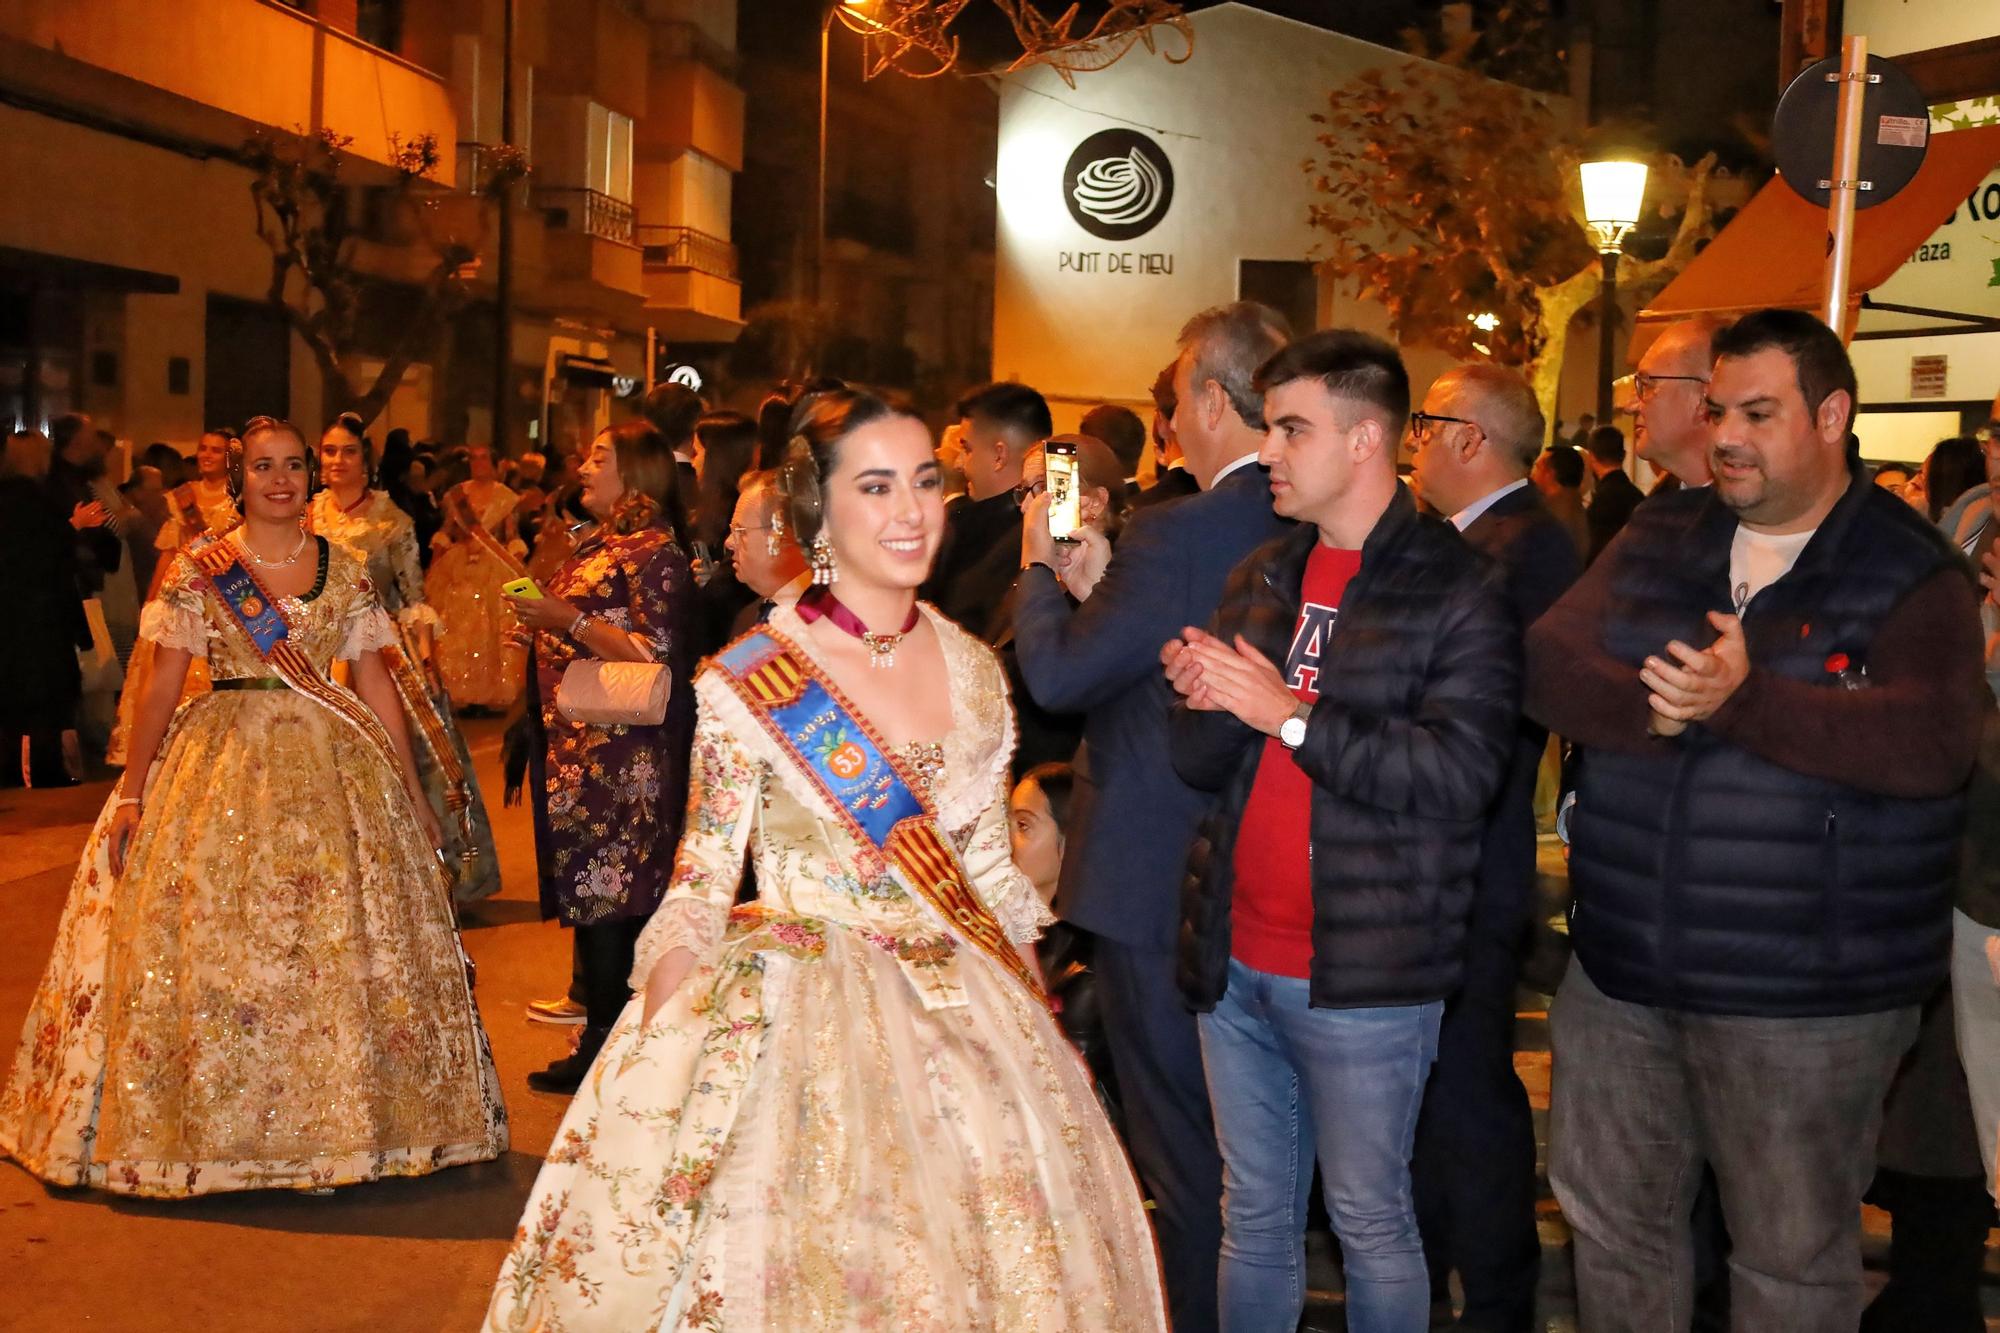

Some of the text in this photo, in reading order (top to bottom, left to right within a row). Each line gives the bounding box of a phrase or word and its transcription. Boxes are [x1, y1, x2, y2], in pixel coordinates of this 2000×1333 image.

[1059, 252, 1173, 275] PUNT DE NEU
[797, 710, 837, 743] 2023
[834, 746, 863, 774] 53
